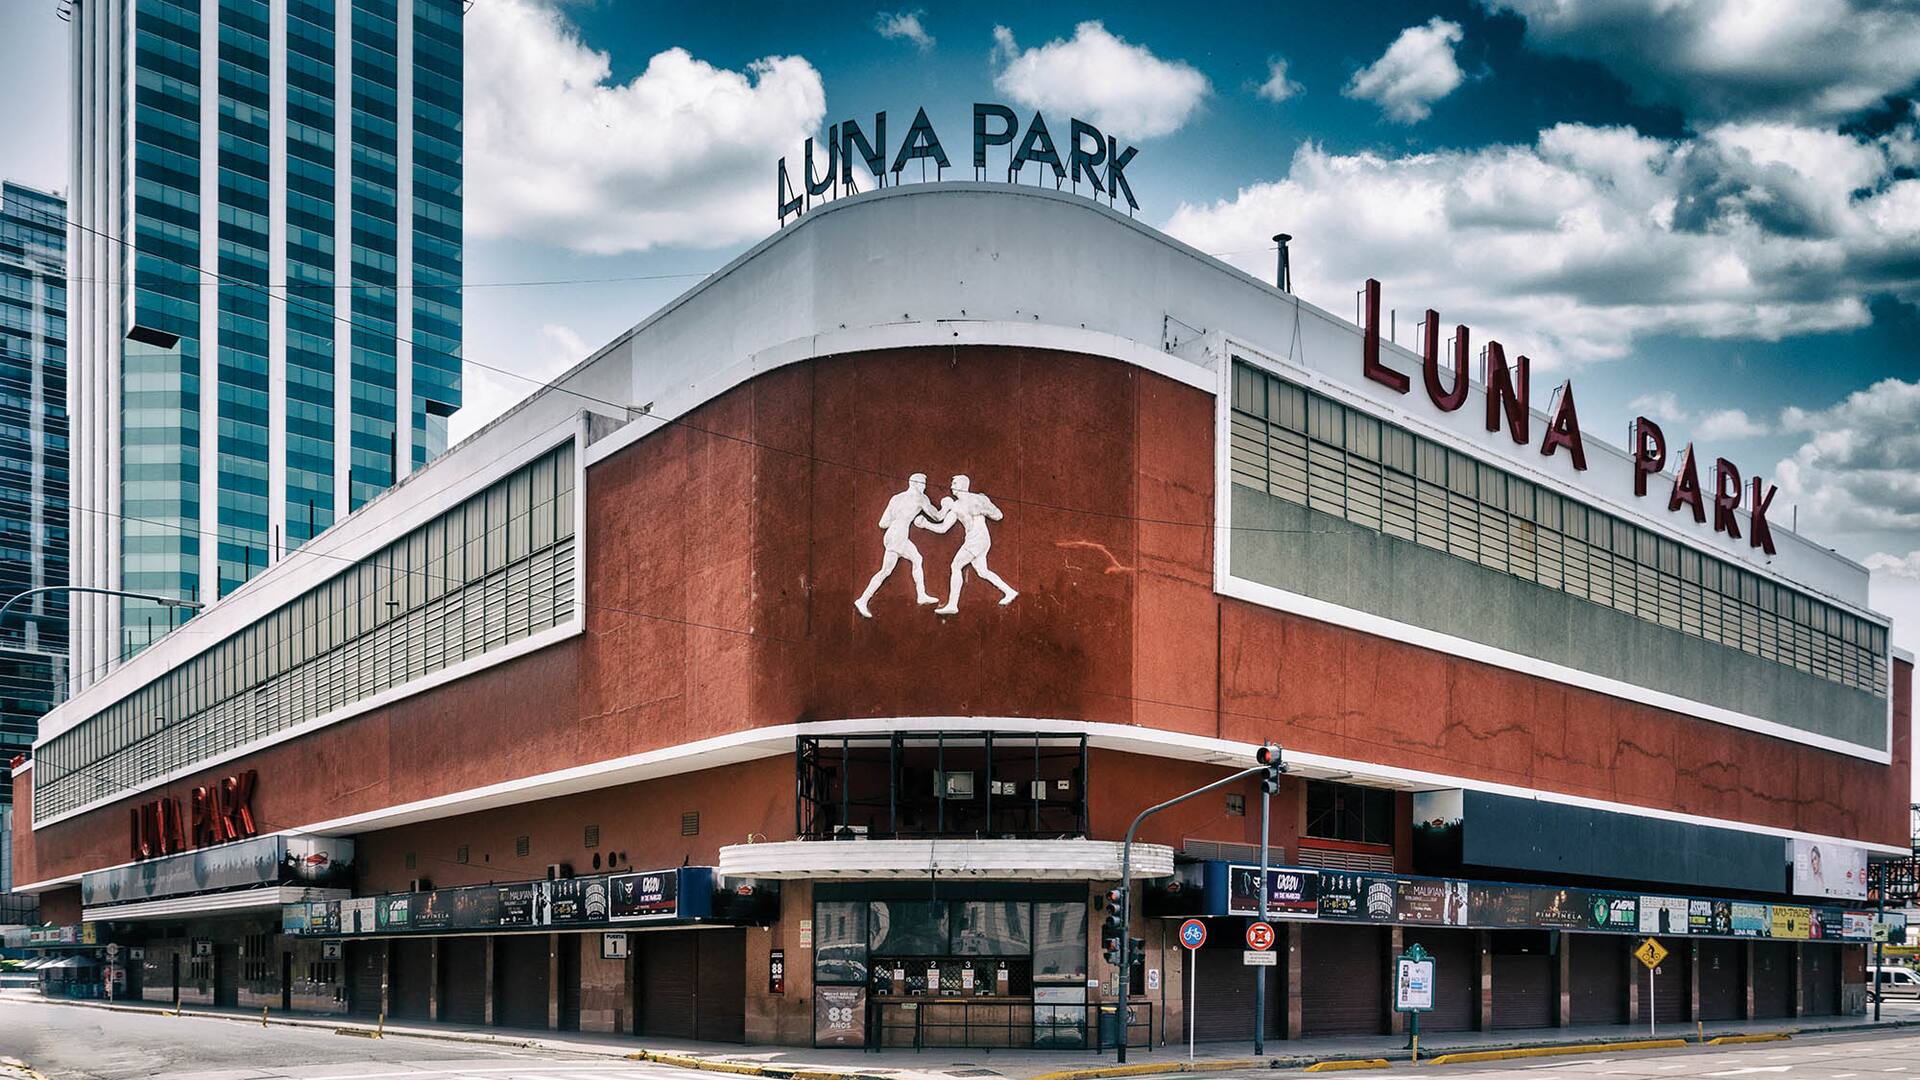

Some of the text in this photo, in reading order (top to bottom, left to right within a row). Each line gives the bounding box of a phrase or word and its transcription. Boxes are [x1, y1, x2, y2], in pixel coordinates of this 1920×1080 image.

[778, 103, 1139, 219] LUNA PARK
[1364, 278, 1778, 555] LUNA PARK
[131, 769, 257, 861] LUNA PARK
[1535, 911, 1583, 920] PIMPINELA
[329, 946, 337, 956] 2
[611, 940, 618, 954] 1
[771, 963, 783, 974] 88
[828, 1007, 853, 1022] 88
[830, 1021, 852, 1029] AÑOS
